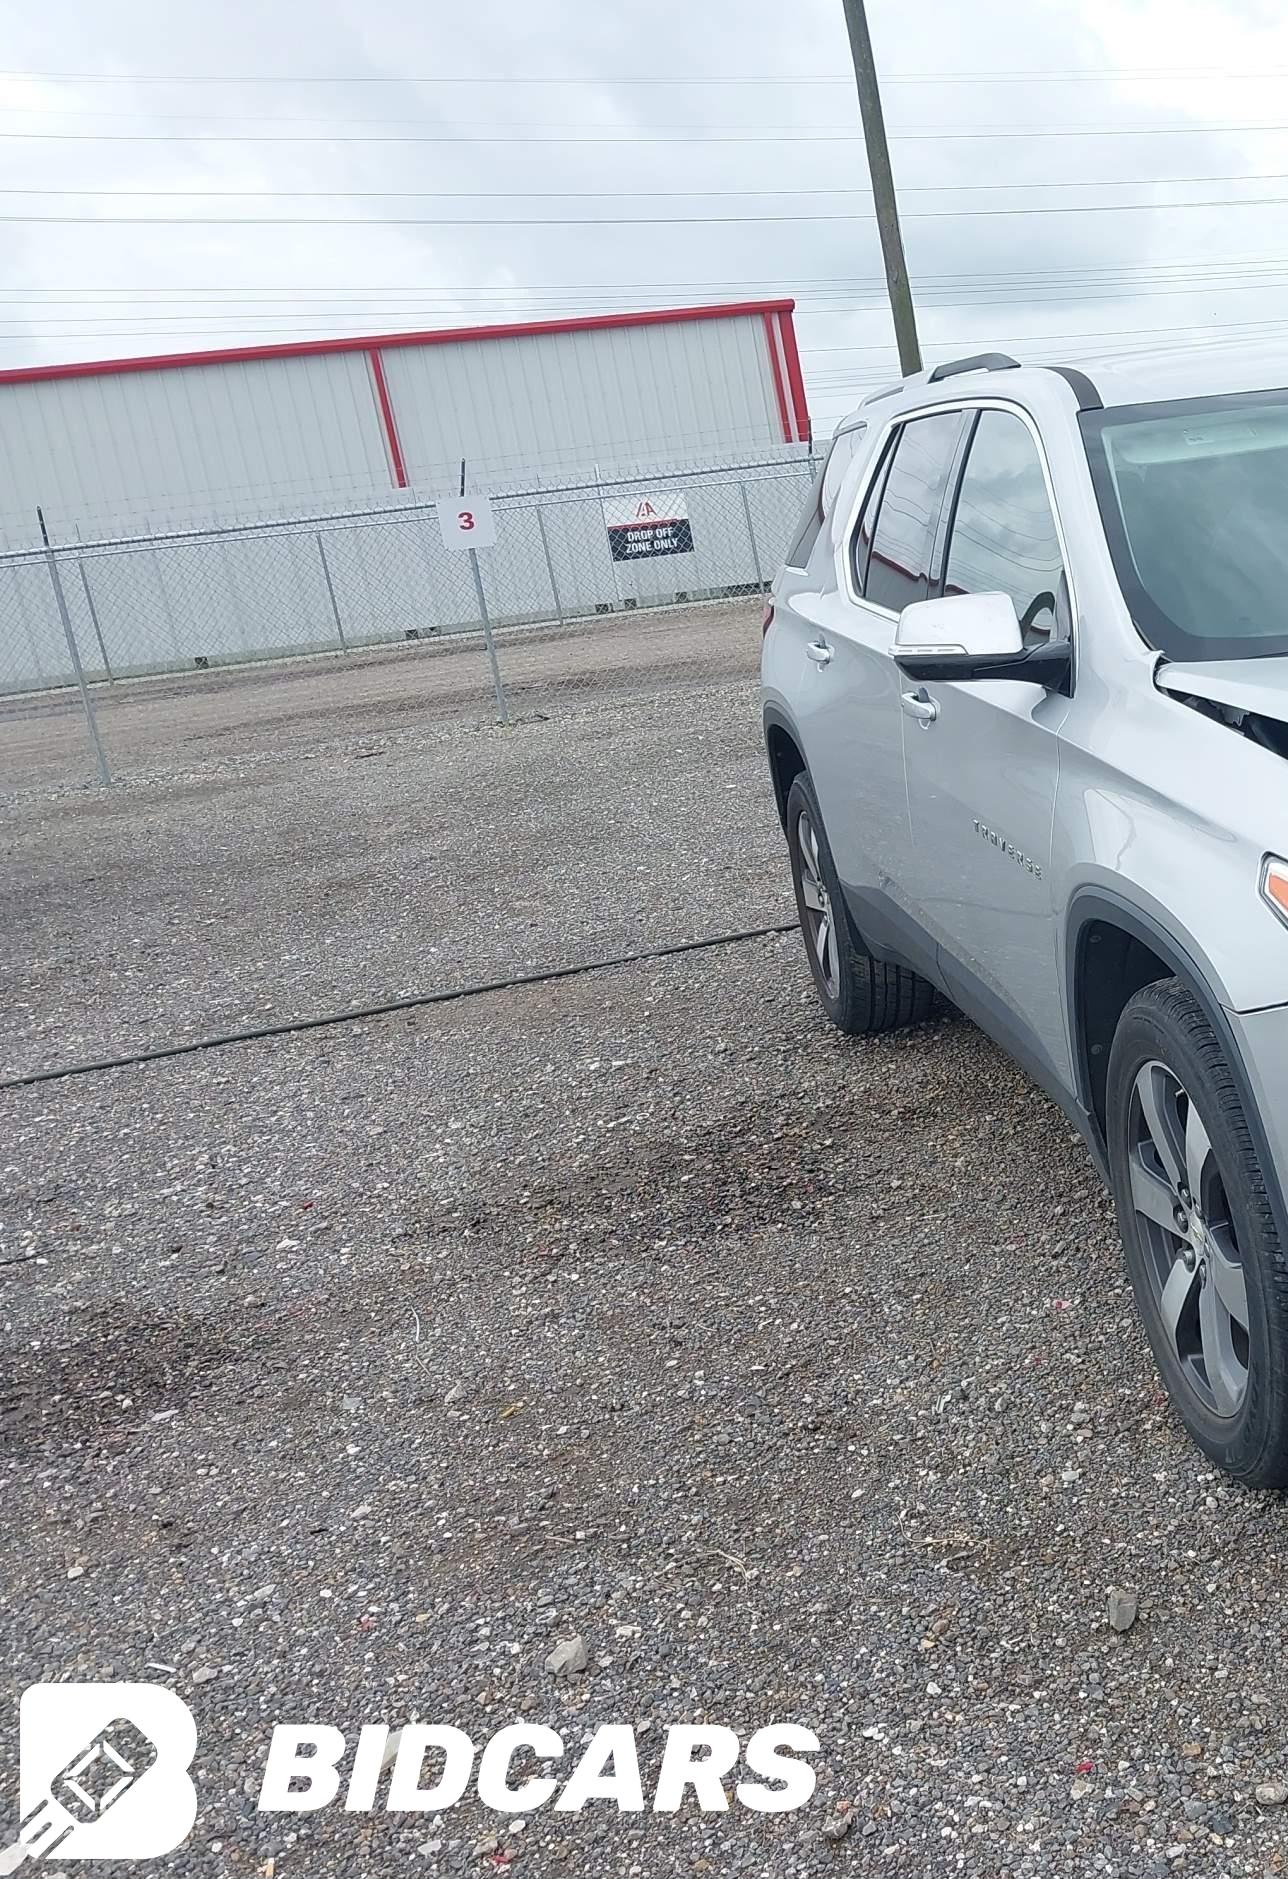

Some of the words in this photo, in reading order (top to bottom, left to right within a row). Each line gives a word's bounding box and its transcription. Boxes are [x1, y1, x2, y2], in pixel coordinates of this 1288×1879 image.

[457, 511, 475, 531] 3
[627, 530, 653, 542] DROP
[655, 527, 674, 538] OFF
[625, 541, 653, 554] ZONE
[653, 538, 679, 551] ONLY
